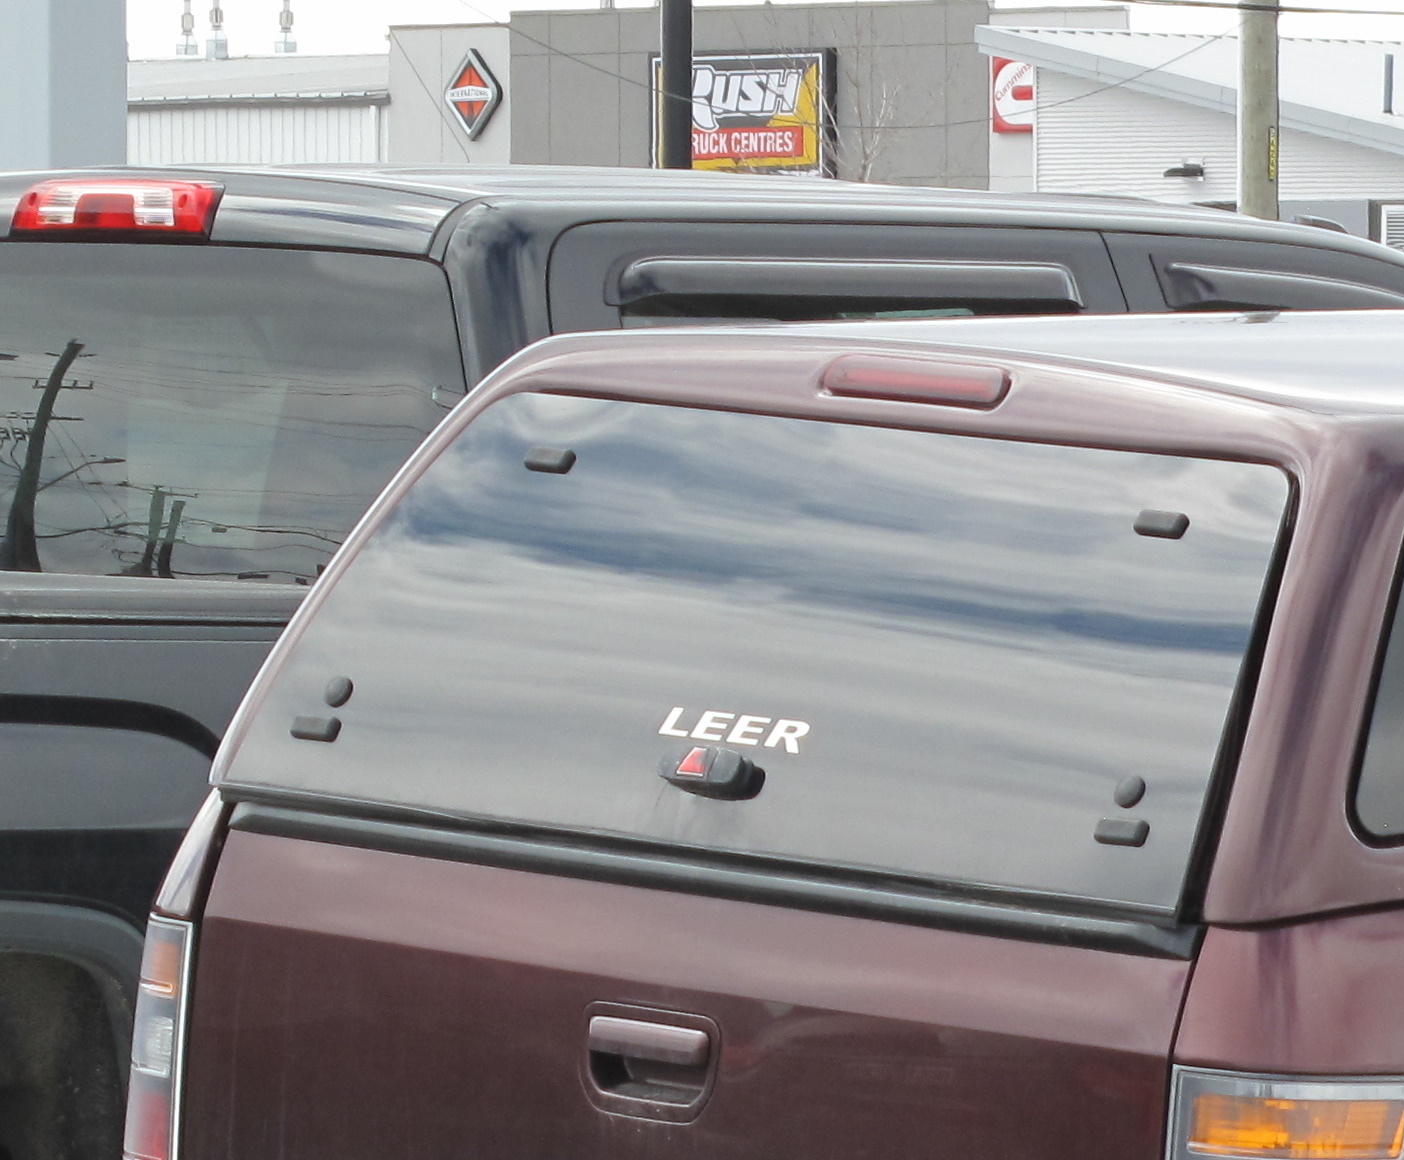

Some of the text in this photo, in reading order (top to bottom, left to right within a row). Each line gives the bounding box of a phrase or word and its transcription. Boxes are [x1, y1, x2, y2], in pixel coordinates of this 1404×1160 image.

[692, 65, 803, 131] RUSH
[693, 131, 793, 154] RUCK CENTRES
[658, 706, 811, 754] LEER
